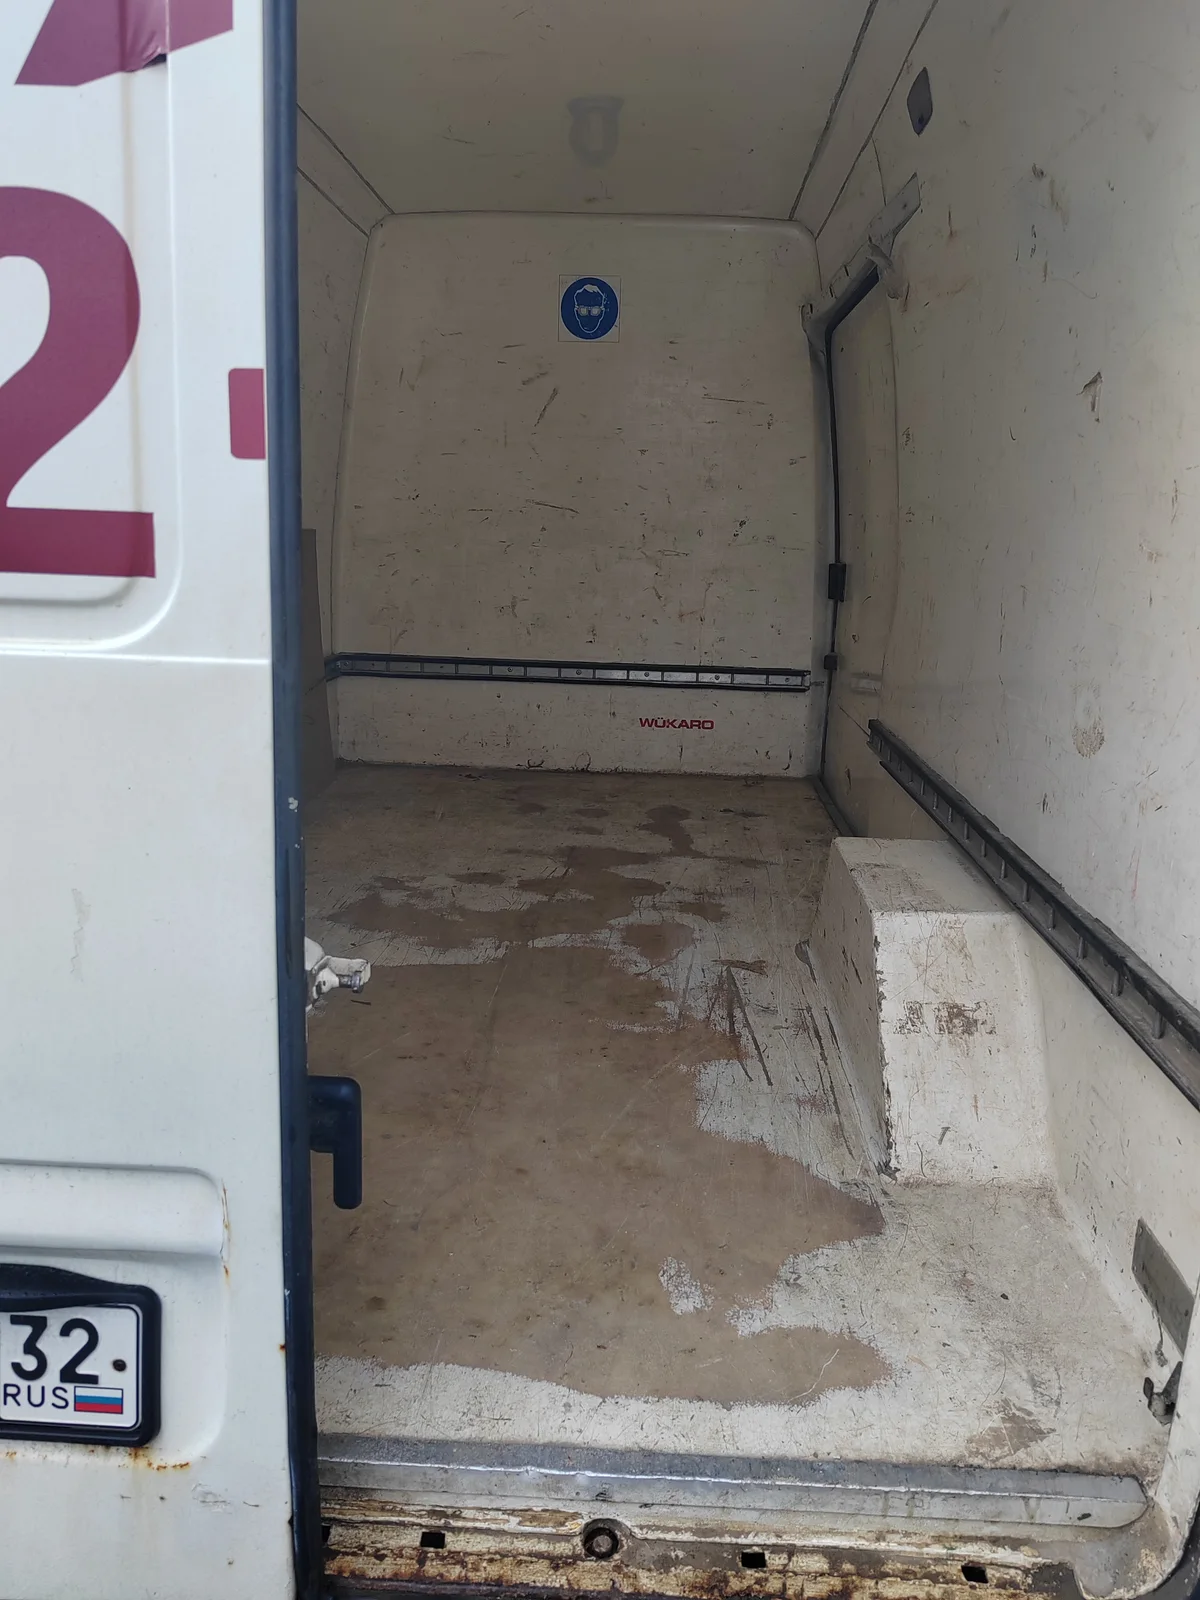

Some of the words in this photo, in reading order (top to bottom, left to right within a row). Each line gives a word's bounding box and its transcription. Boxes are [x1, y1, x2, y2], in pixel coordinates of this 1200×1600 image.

[639, 717, 714, 729] WÜKARO
[10, 1314, 99, 1384] 32
[3, 1383, 69, 1410] RUS
